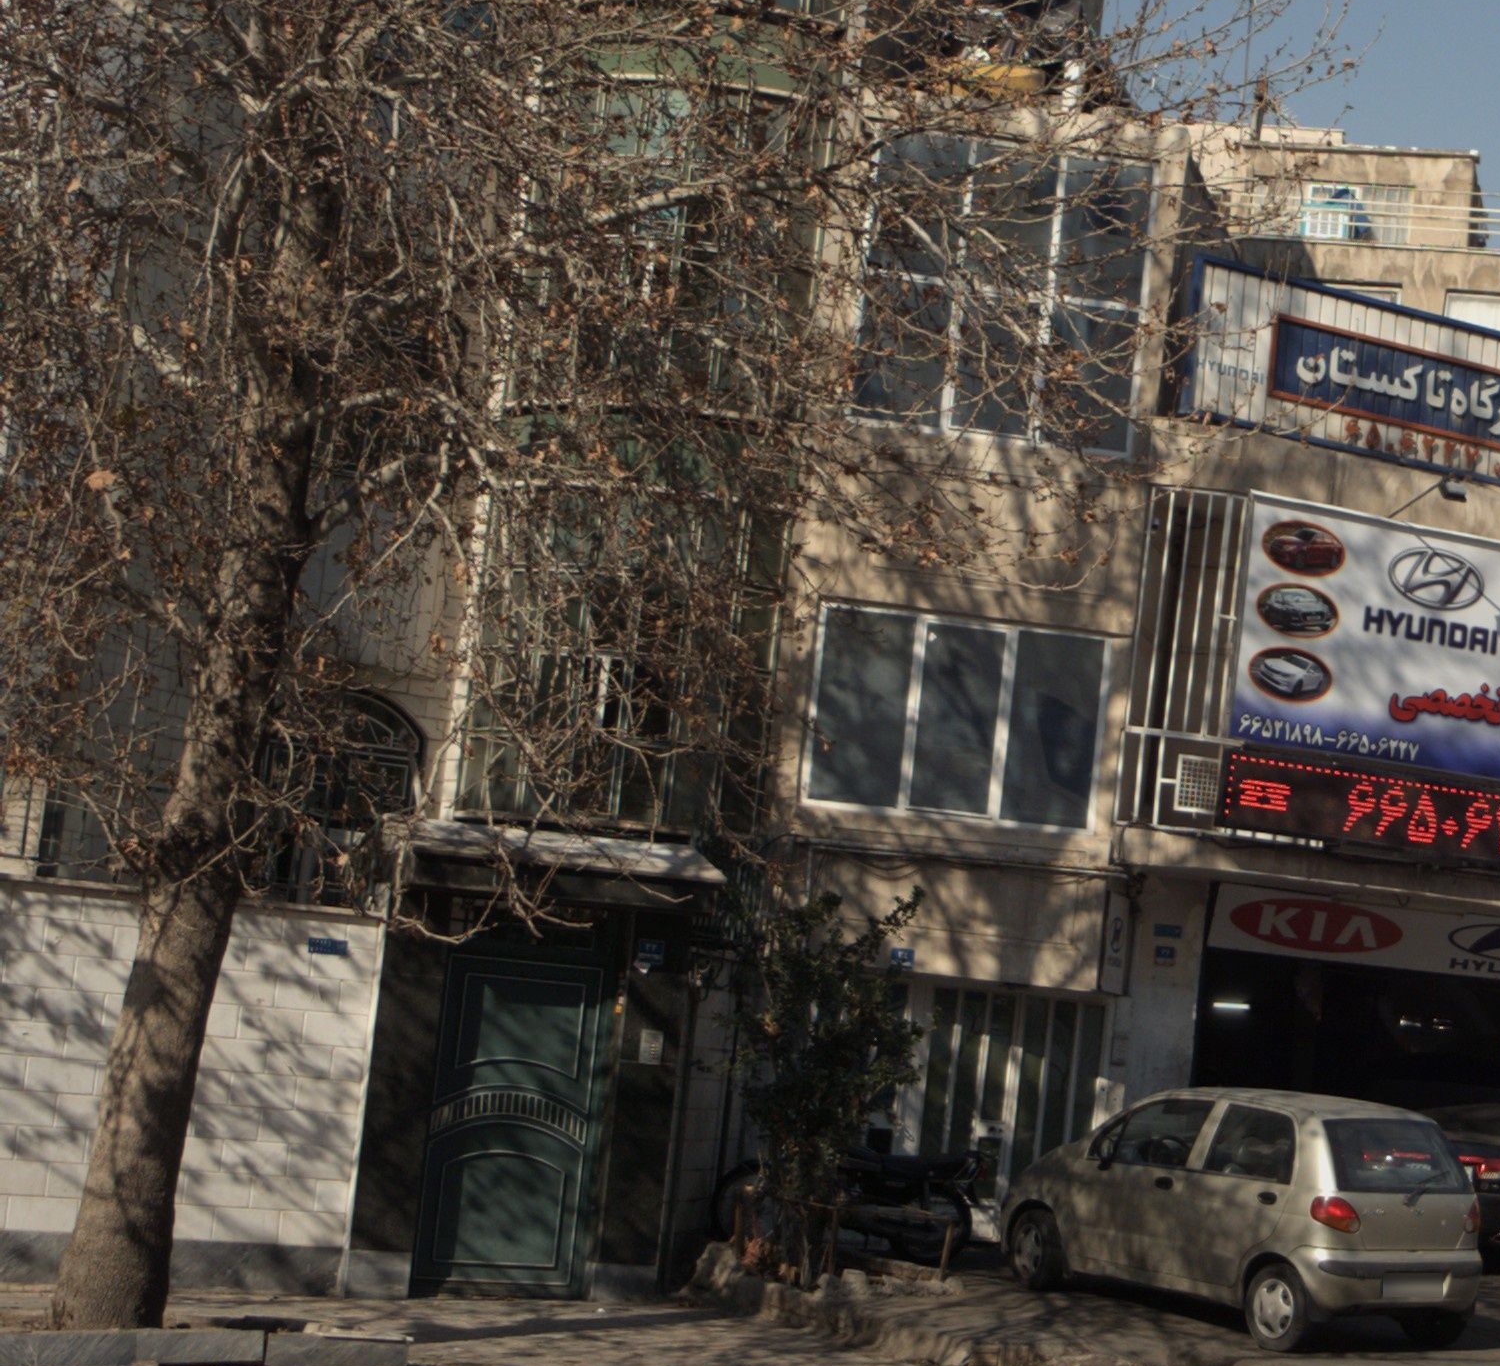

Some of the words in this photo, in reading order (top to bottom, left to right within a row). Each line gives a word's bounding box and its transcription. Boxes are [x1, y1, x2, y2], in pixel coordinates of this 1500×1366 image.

[1295, 345, 1453, 410] تاکستان
[1362, 605, 1498, 656] HYUNDAI
[1257, 901, 1380, 949] KIA
